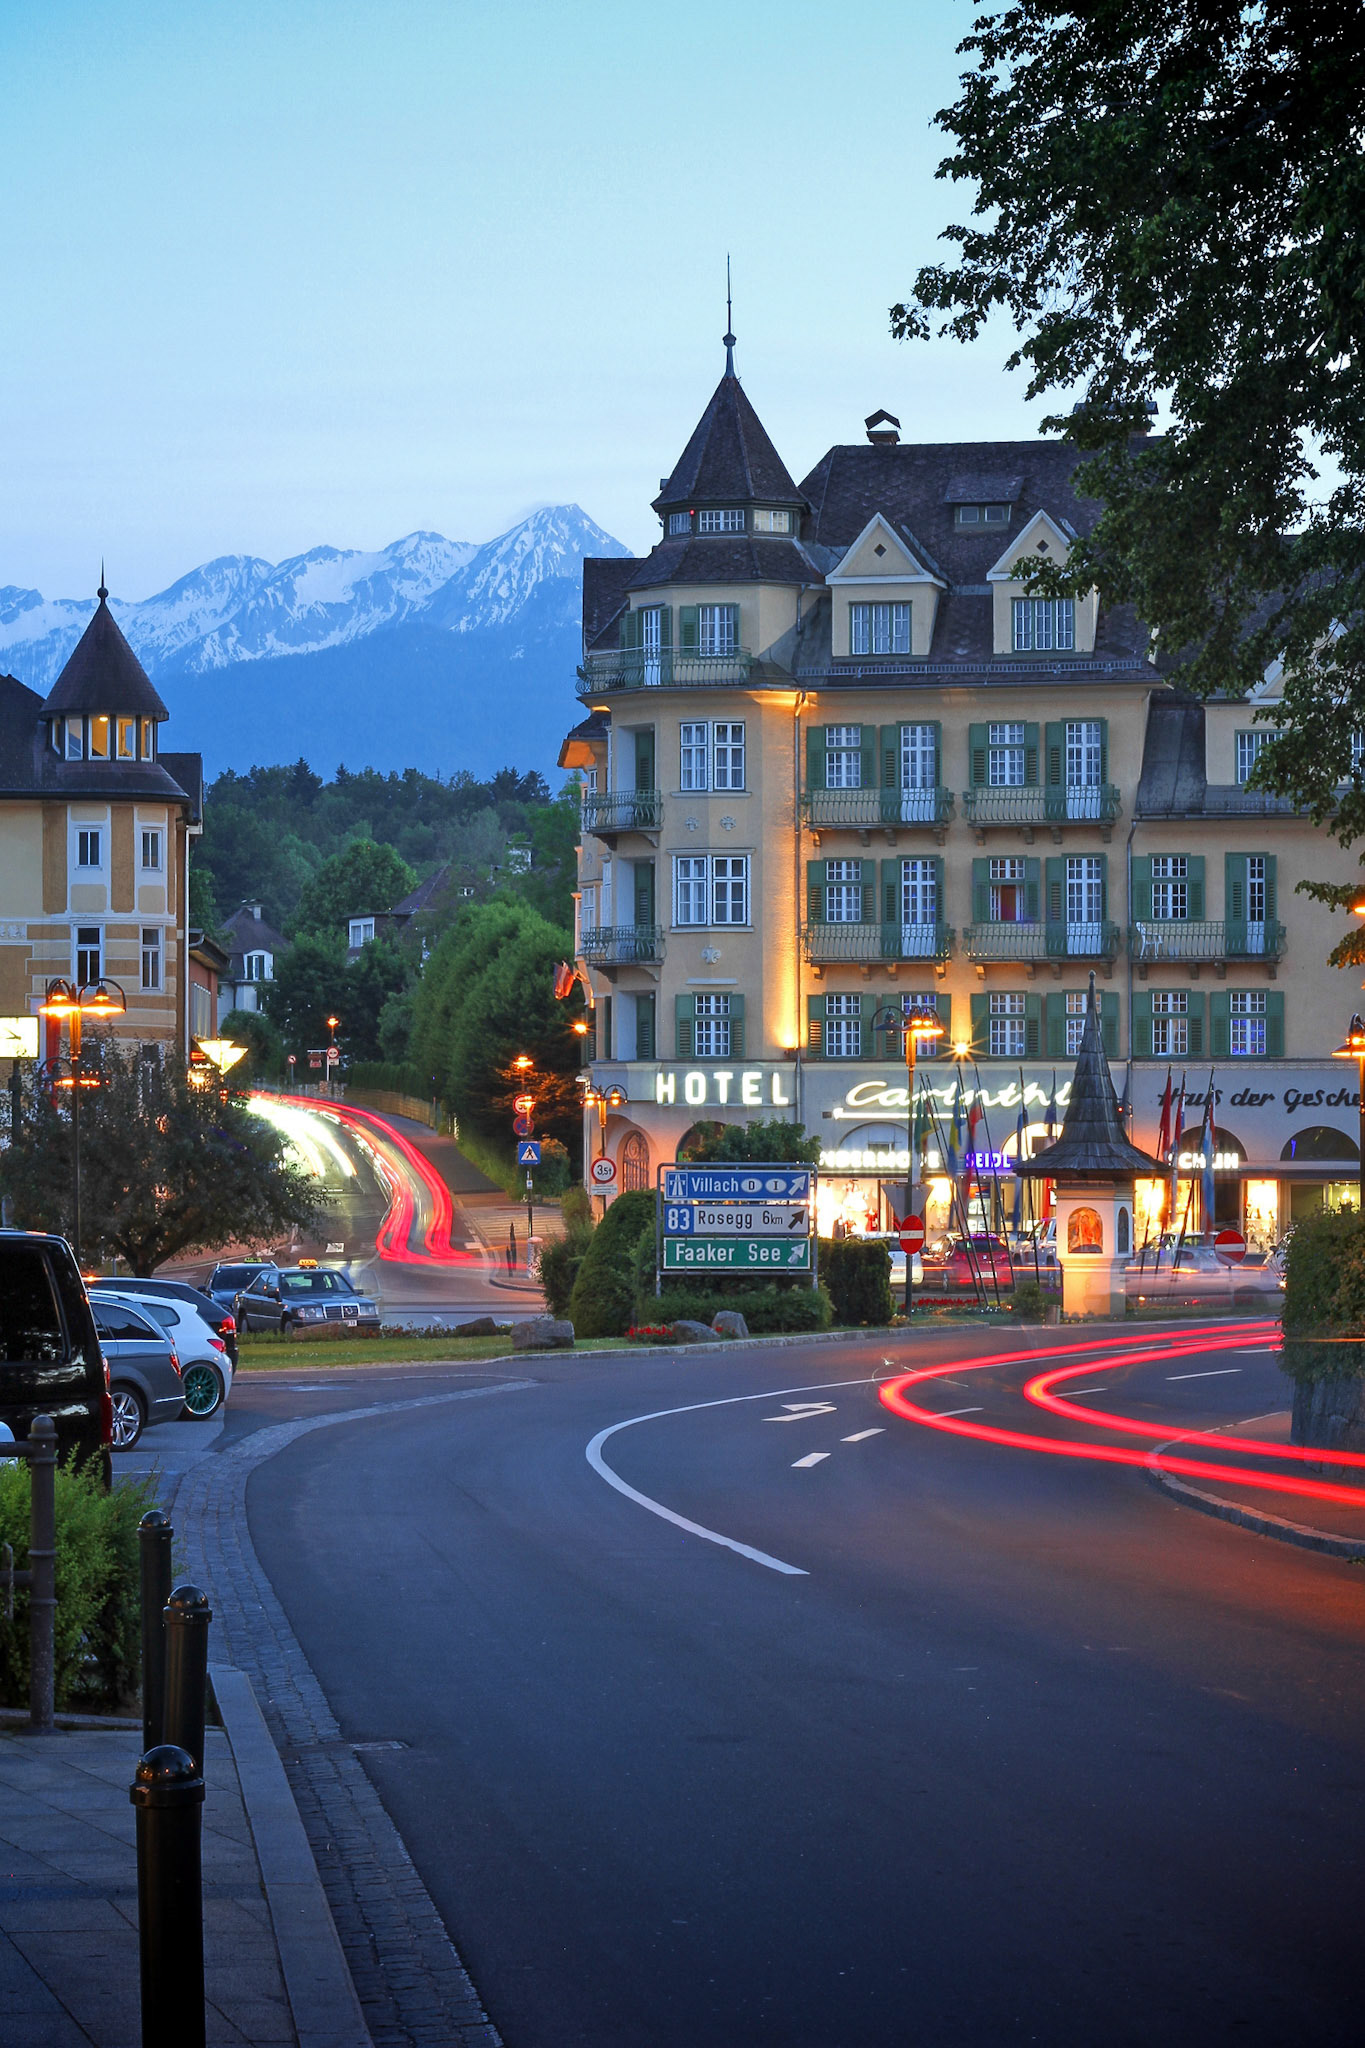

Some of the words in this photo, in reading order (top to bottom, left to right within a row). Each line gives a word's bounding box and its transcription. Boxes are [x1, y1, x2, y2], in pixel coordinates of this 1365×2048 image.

[656, 1071, 789, 1105] HOTEL
[845, 1080, 1073, 1107] Carinthi
[1231, 1087, 1275, 1107] der
[691, 1177, 739, 1192] Villach
[748, 1180, 755, 1190] D
[772, 1180, 778, 1190] I
[667, 1208, 690, 1231] 83
[698, 1210, 753, 1229] Rosegg
[675, 1243, 735, 1261] Faaker
[748, 1243, 781, 1261] See
